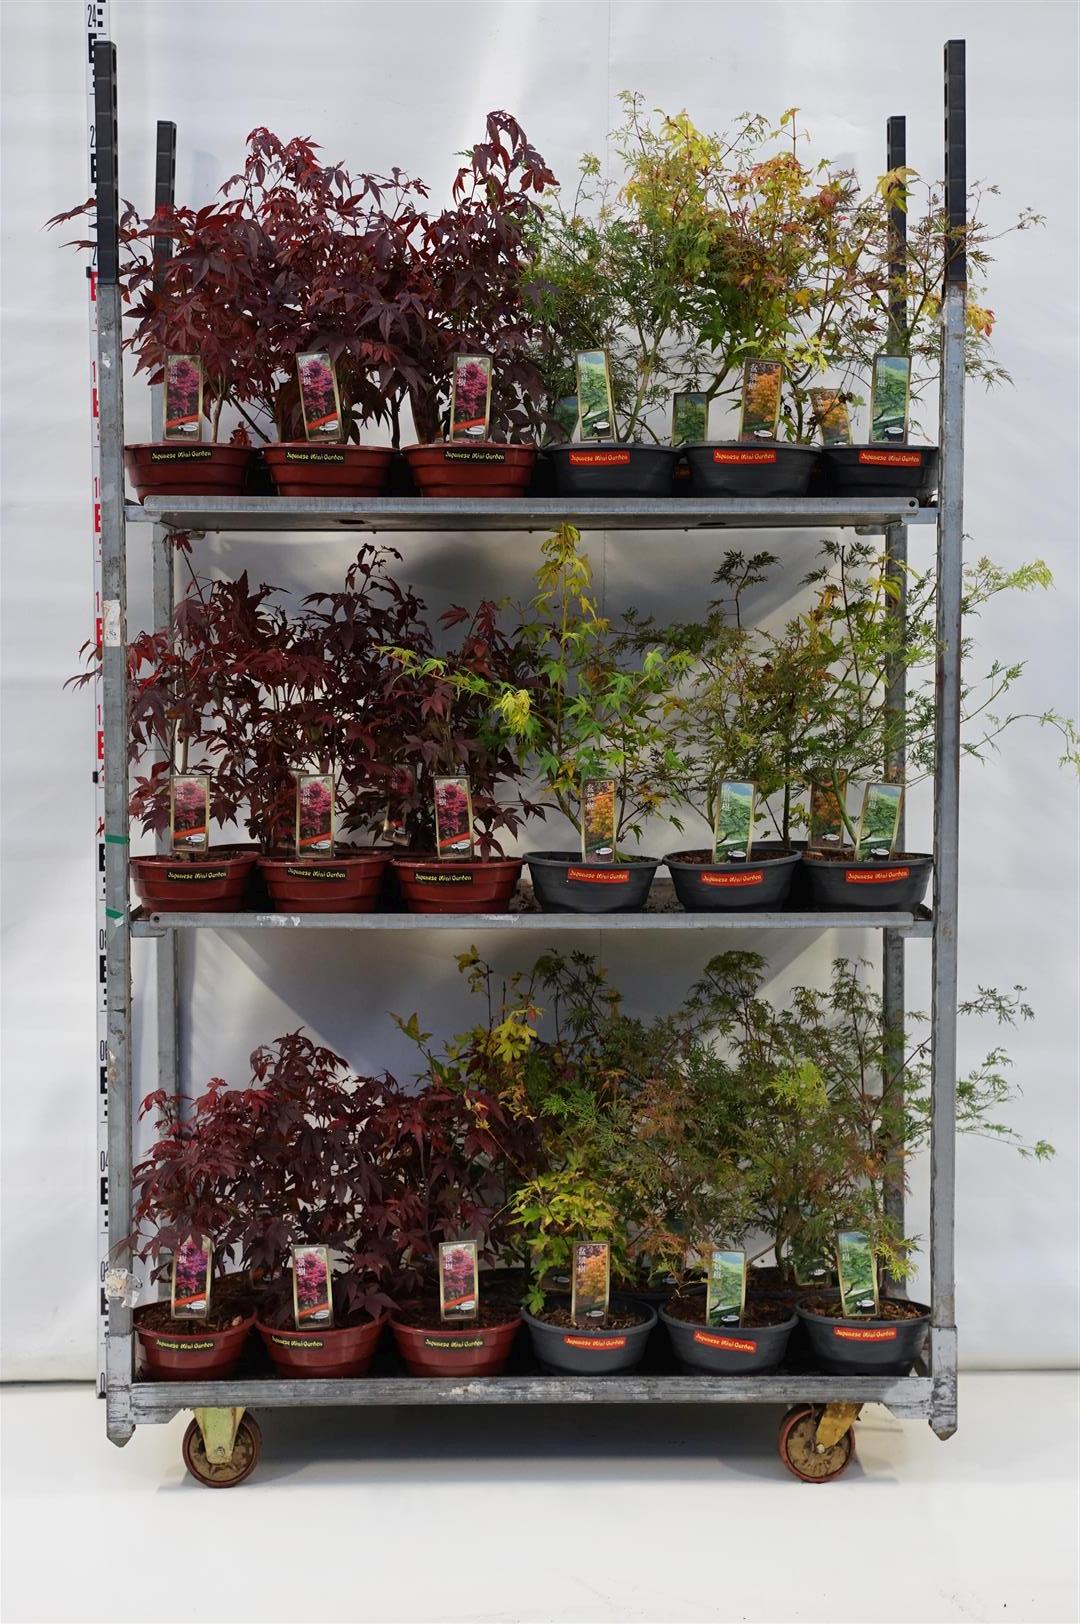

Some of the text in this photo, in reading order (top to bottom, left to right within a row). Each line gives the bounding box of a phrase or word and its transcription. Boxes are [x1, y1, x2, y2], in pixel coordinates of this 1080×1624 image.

[88, 4, 97, 27] 24
[90, 125, 96, 148] 2
[570, 454, 593, 462] Japanese
[715, 452, 739, 460] Japanese
[861, 453, 887, 461] Japanese
[901, 455, 920, 463] Garden
[570, 870, 595, 879] Japanese
[702, 875, 728, 883] Japanese
[743, 874, 762, 882] Garden
[888, 870, 907, 878] Garden
[835, 1329, 861, 1338] Japanese
[566, 1337, 591, 1346] Japanese
[606, 1338, 624, 1346] Garden
[695, 1333, 719, 1344] Japanese
[734, 1341, 754, 1351] Garden
